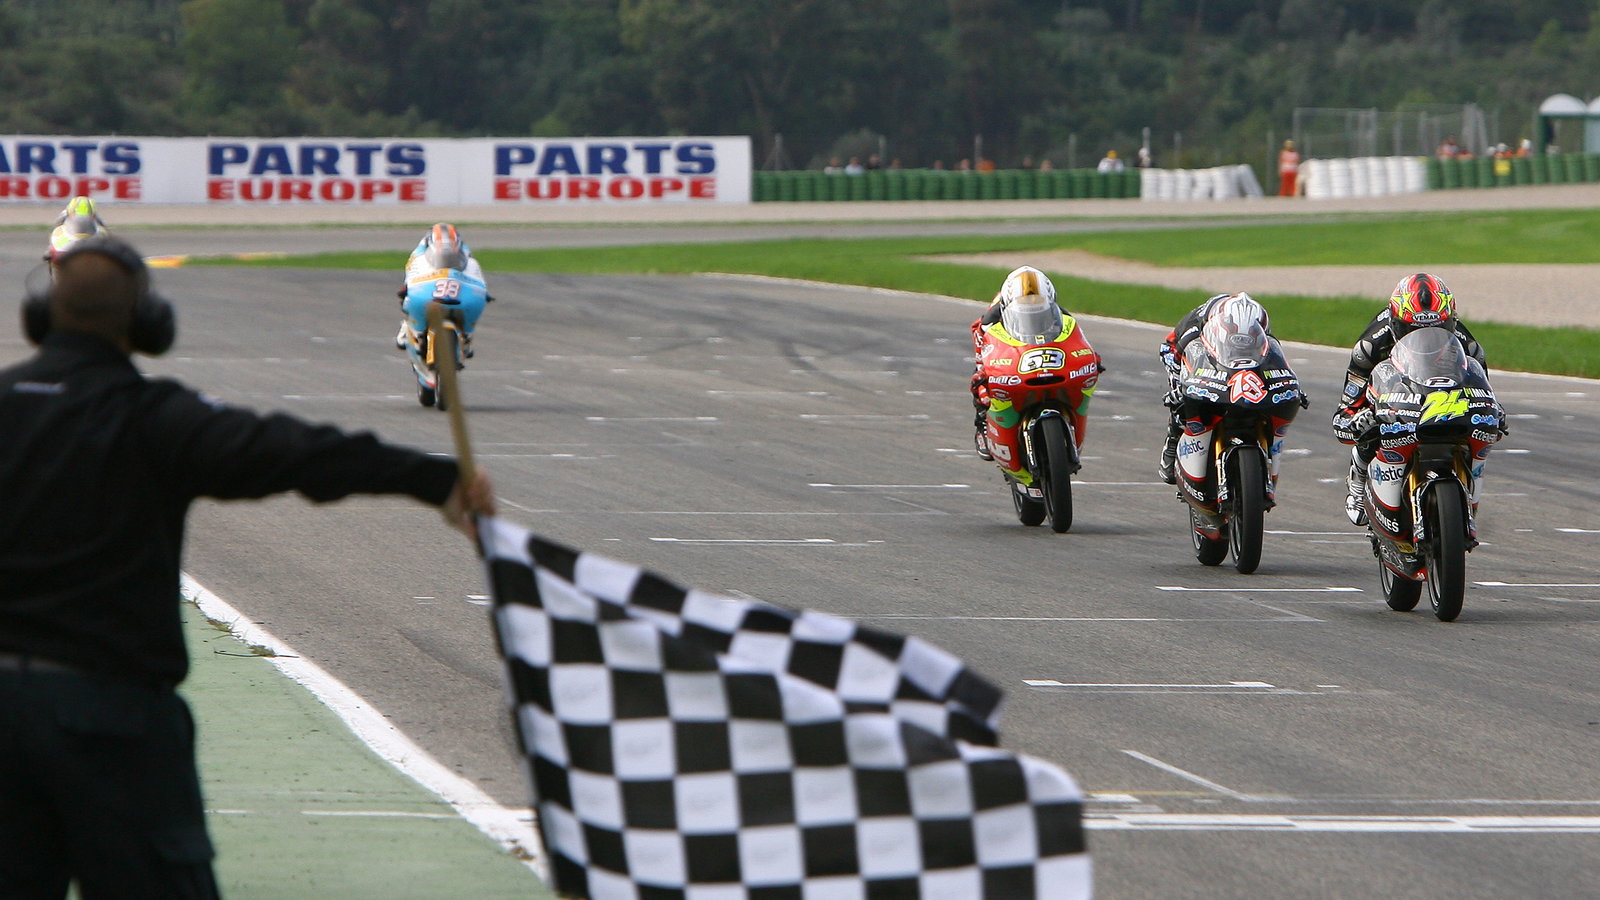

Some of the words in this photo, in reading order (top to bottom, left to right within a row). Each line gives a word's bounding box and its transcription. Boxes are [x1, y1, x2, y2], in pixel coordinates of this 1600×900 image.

[0, 143, 142, 175] RTS
[208, 142, 427, 176] PARTS
[494, 143, 717, 175] PARTS
[207, 178, 427, 201] EUROPE
[494, 177, 717, 200] EUROPE
[432, 279, 460, 298] 38
[1413, 313, 1440, 322] VEMAR
[1020, 349, 1063, 373] 63
[1419, 389, 1470, 425] 24
